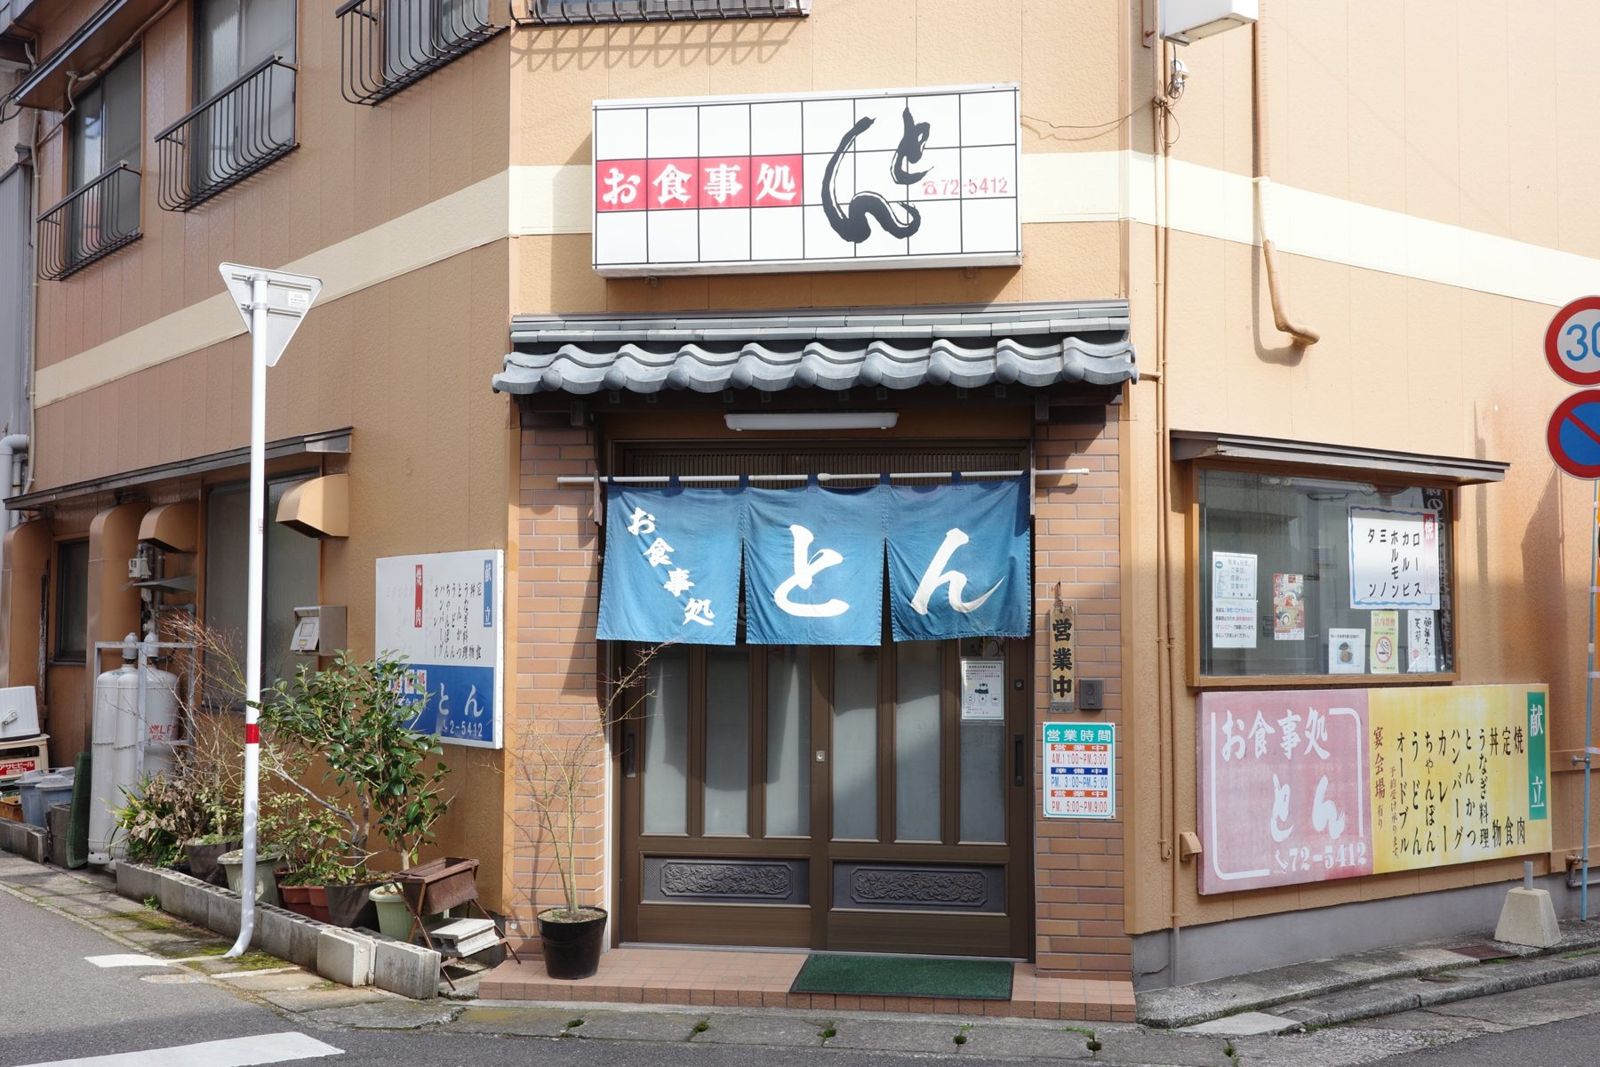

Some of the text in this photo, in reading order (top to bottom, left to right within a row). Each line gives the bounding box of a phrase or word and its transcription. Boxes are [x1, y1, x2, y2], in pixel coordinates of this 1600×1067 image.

[602, 162, 797, 204] お食事処
[627, 507, 715, 627] お食事処
[774, 524, 1006, 618] とん
[1368, 528, 1376, 597] タン
[1380, 529, 1387, 597] ミノ
[1391, 530, 1399, 598] ホルモン
[1413, 532, 1421, 597] ロース
[438, 682, 485, 717] とん
[1052, 618, 1073, 698] 営業中
[1047, 728, 1111, 742] 営業時間
[1221, 706, 1330, 762] お食事処
[1530, 703, 1544, 808] 献立
[1270, 773, 1346, 842] とん
[1397, 731, 1409, 853] オードブル
[1412, 731, 1422, 856] うどん
[1438, 729, 1448, 852] カレー
[1451, 729, 1463, 850] ハンバーグ
[1465, 728, 1476, 846] とんかつ
[1478, 728, 1490, 849] うなぎ料理
[1489, 727, 1501, 847] 丼物
[1502, 726, 1514, 846] 定食
[1514, 726, 1525, 845] 焼肉
[1288, 842, 1367, 872] 72-5412
